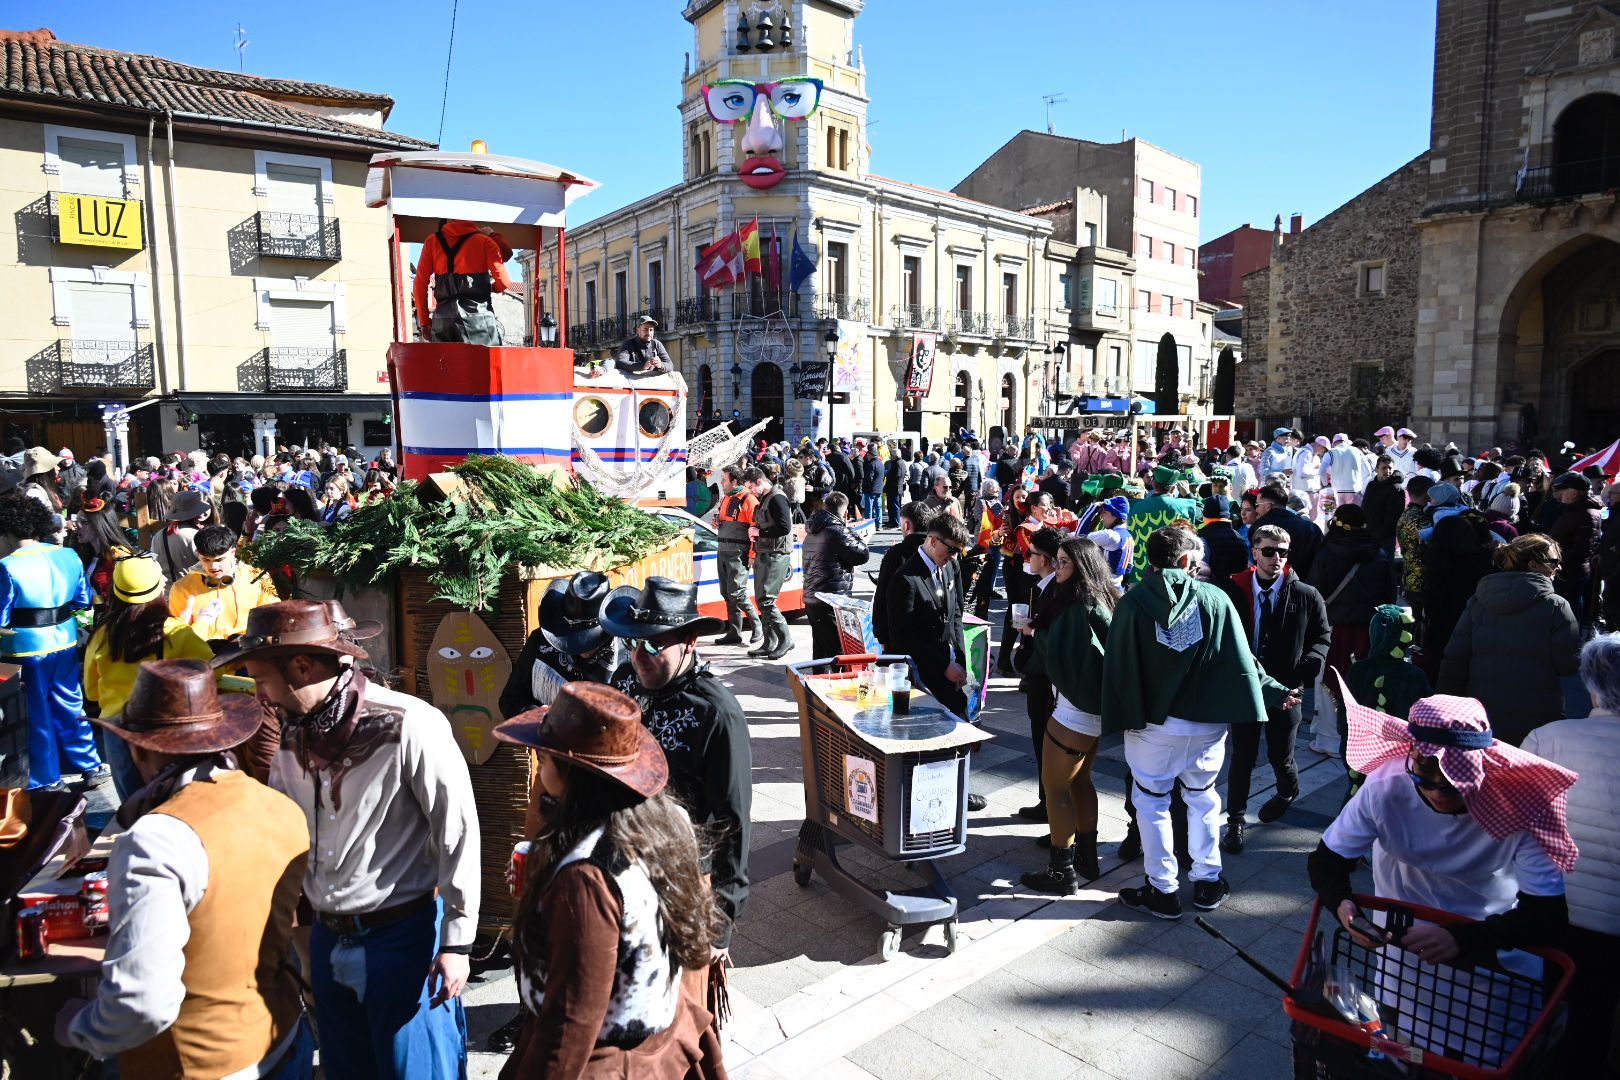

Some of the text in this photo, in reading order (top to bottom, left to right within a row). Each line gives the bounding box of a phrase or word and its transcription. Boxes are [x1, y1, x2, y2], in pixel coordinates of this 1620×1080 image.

[76, 198, 128, 239] LUZ
[1100, 400, 1113, 408] BBVA
[1046, 419, 1079, 428] TABERNA
[1085, 418, 1097, 427] DE
